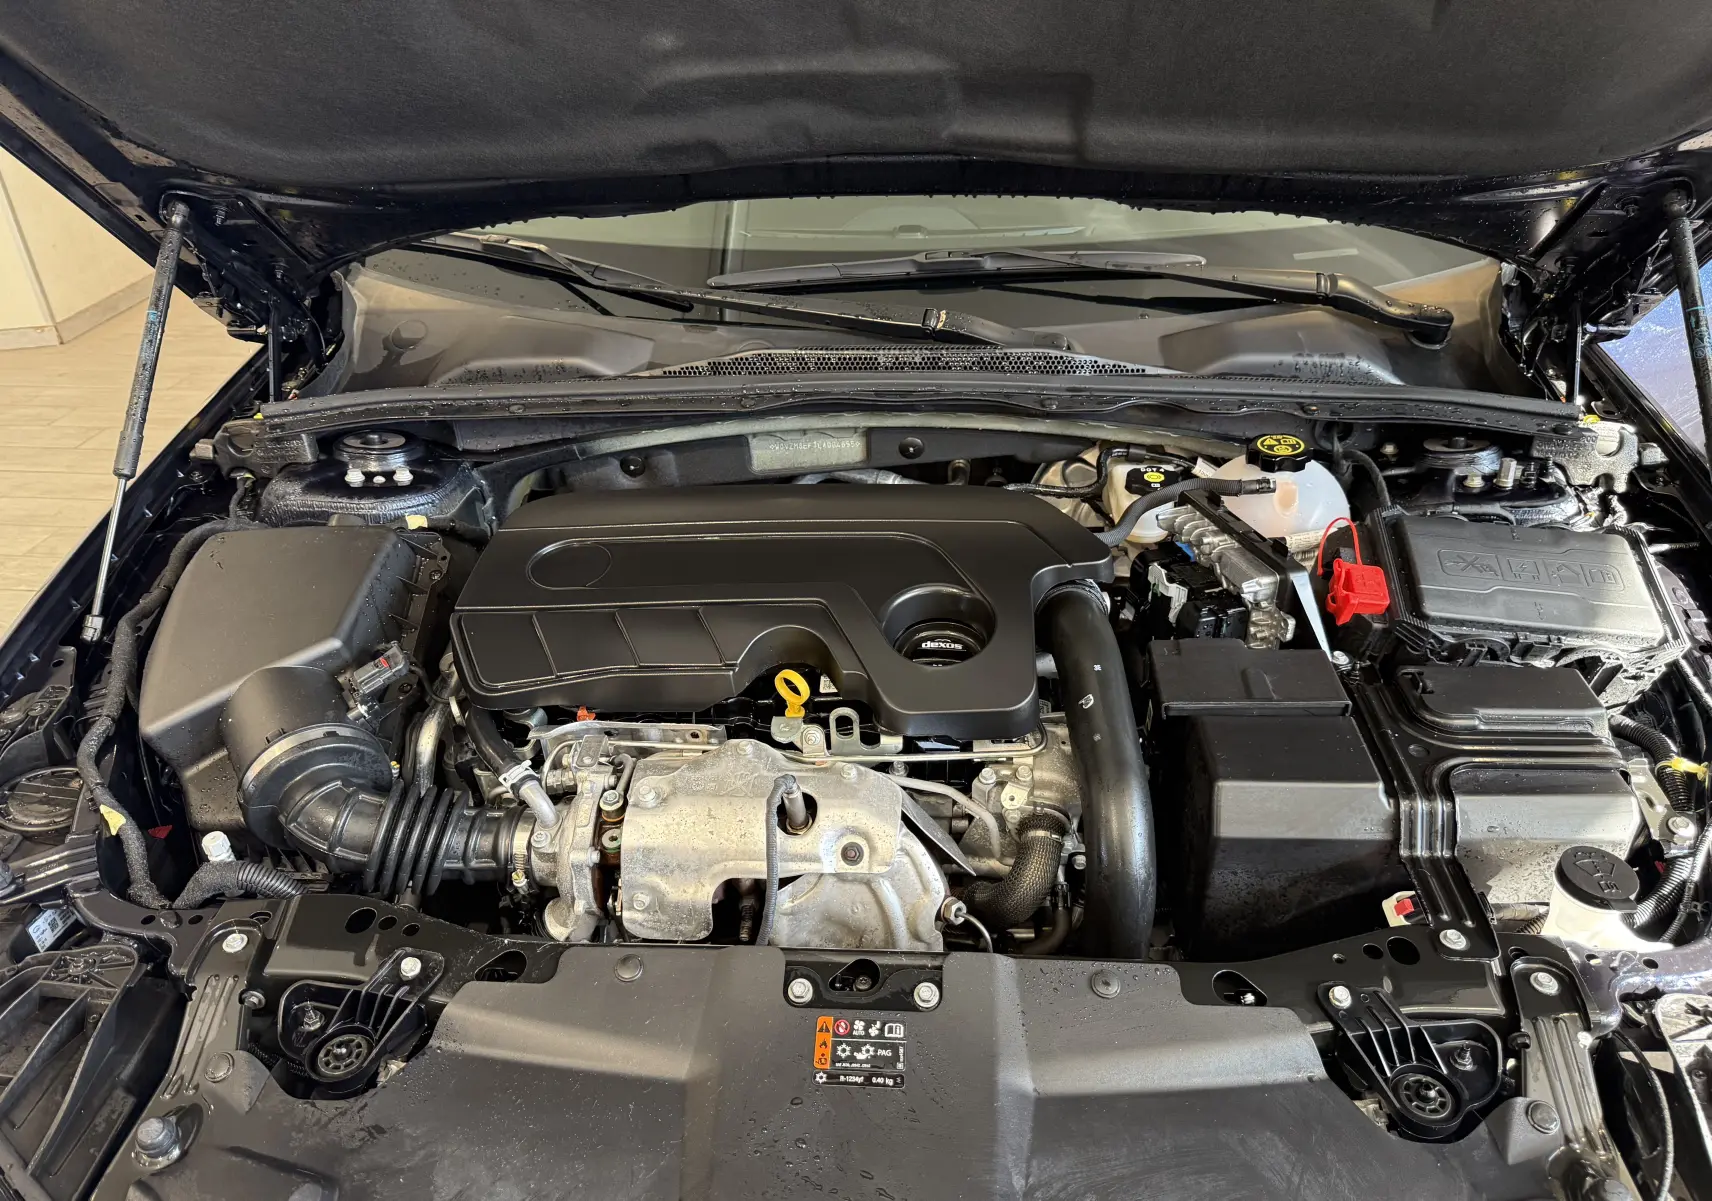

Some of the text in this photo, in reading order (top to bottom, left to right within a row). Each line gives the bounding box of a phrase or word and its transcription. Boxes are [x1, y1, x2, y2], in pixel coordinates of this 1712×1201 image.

[921, 640, 964, 650] dexos
[876, 1048, 892, 1057] PAG
[885, 1077, 894, 1087] kg
